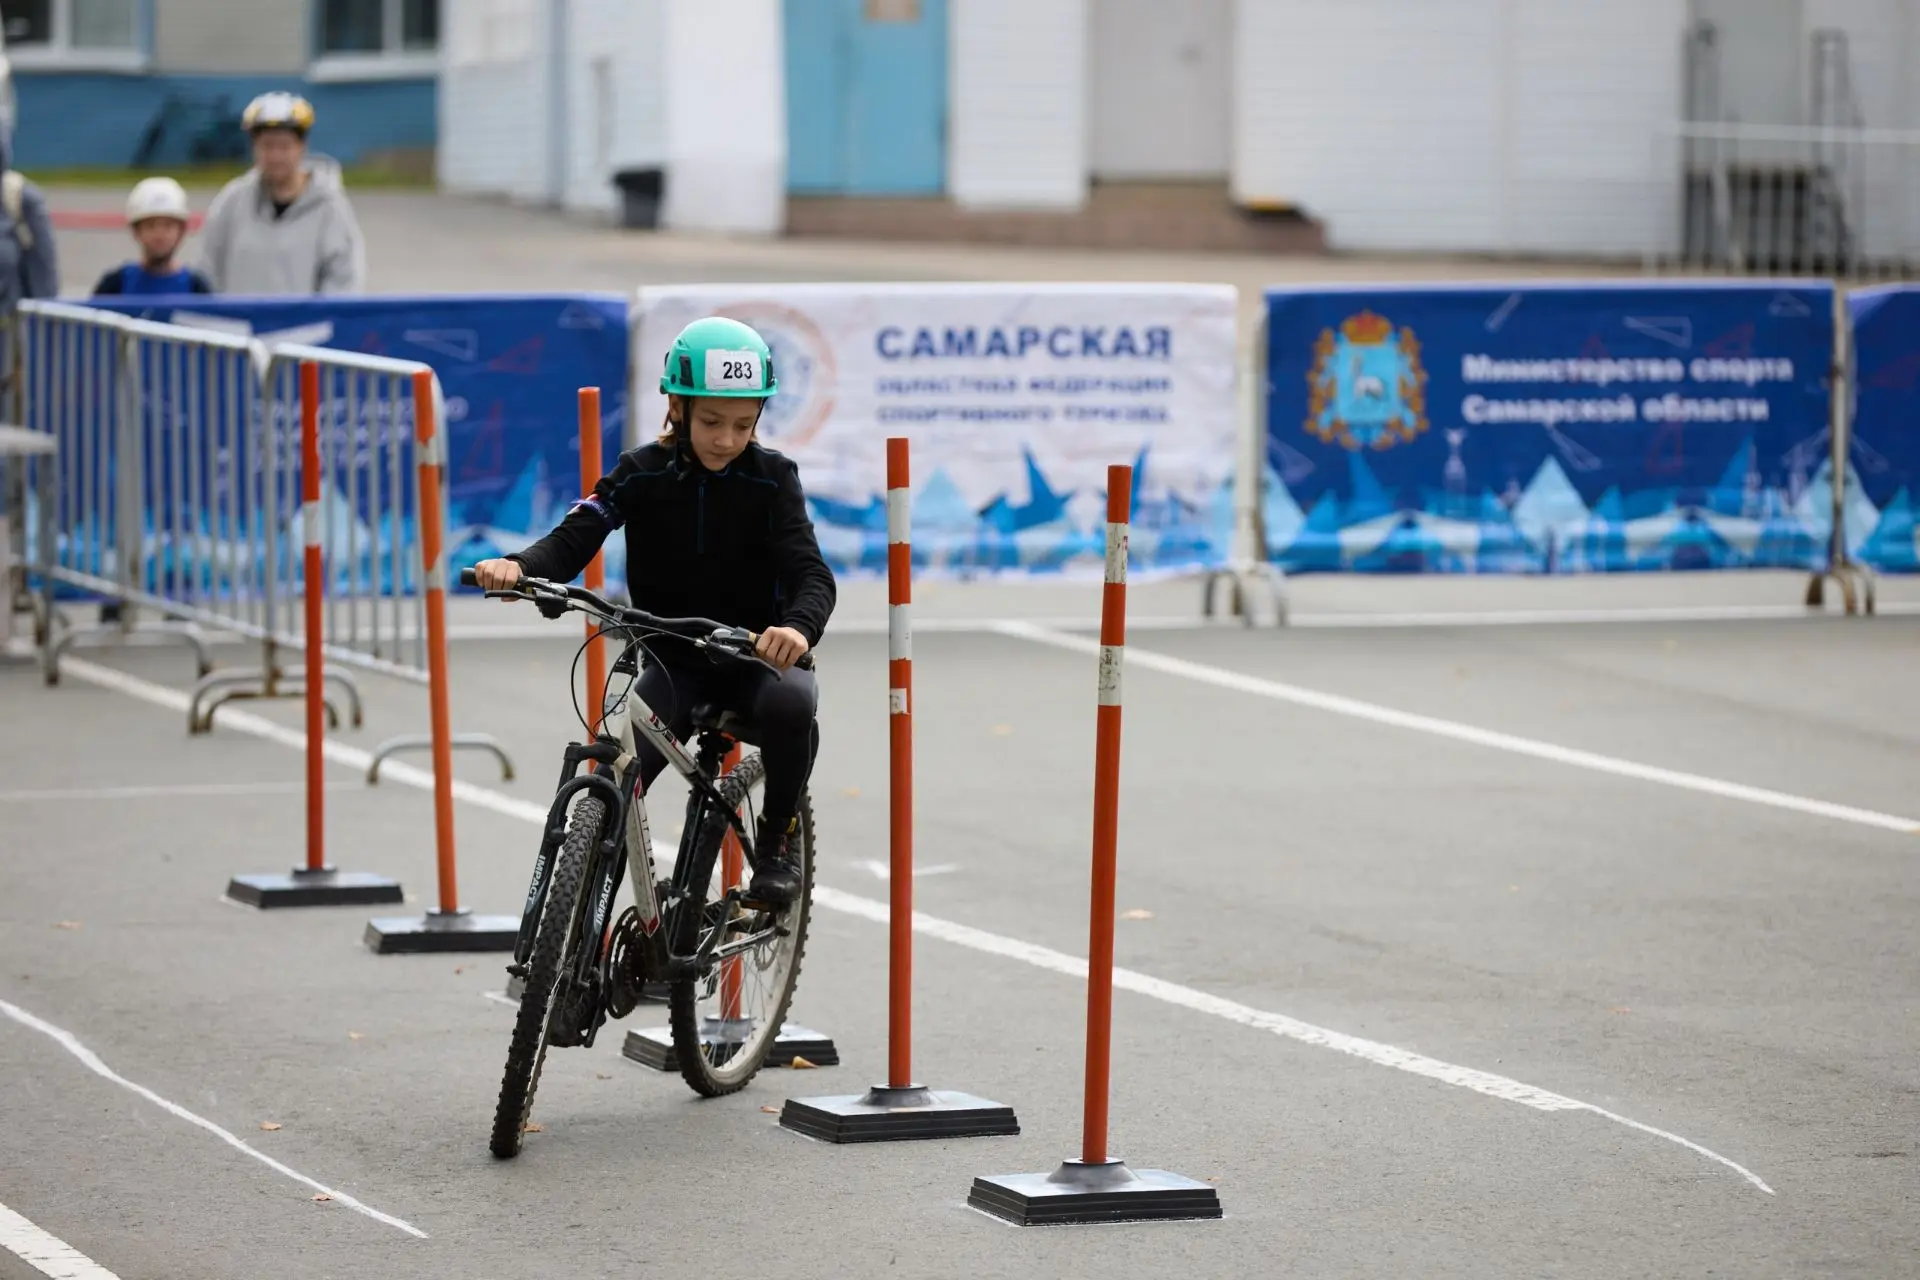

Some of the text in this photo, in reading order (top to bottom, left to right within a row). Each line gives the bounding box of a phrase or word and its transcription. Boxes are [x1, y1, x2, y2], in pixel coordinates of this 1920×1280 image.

[876, 327, 1172, 358] САМАРСКАЯ
[722, 361, 753, 380] 283
[528, 854, 546, 905] IMPACT
[595, 873, 613, 925] IMPACT
